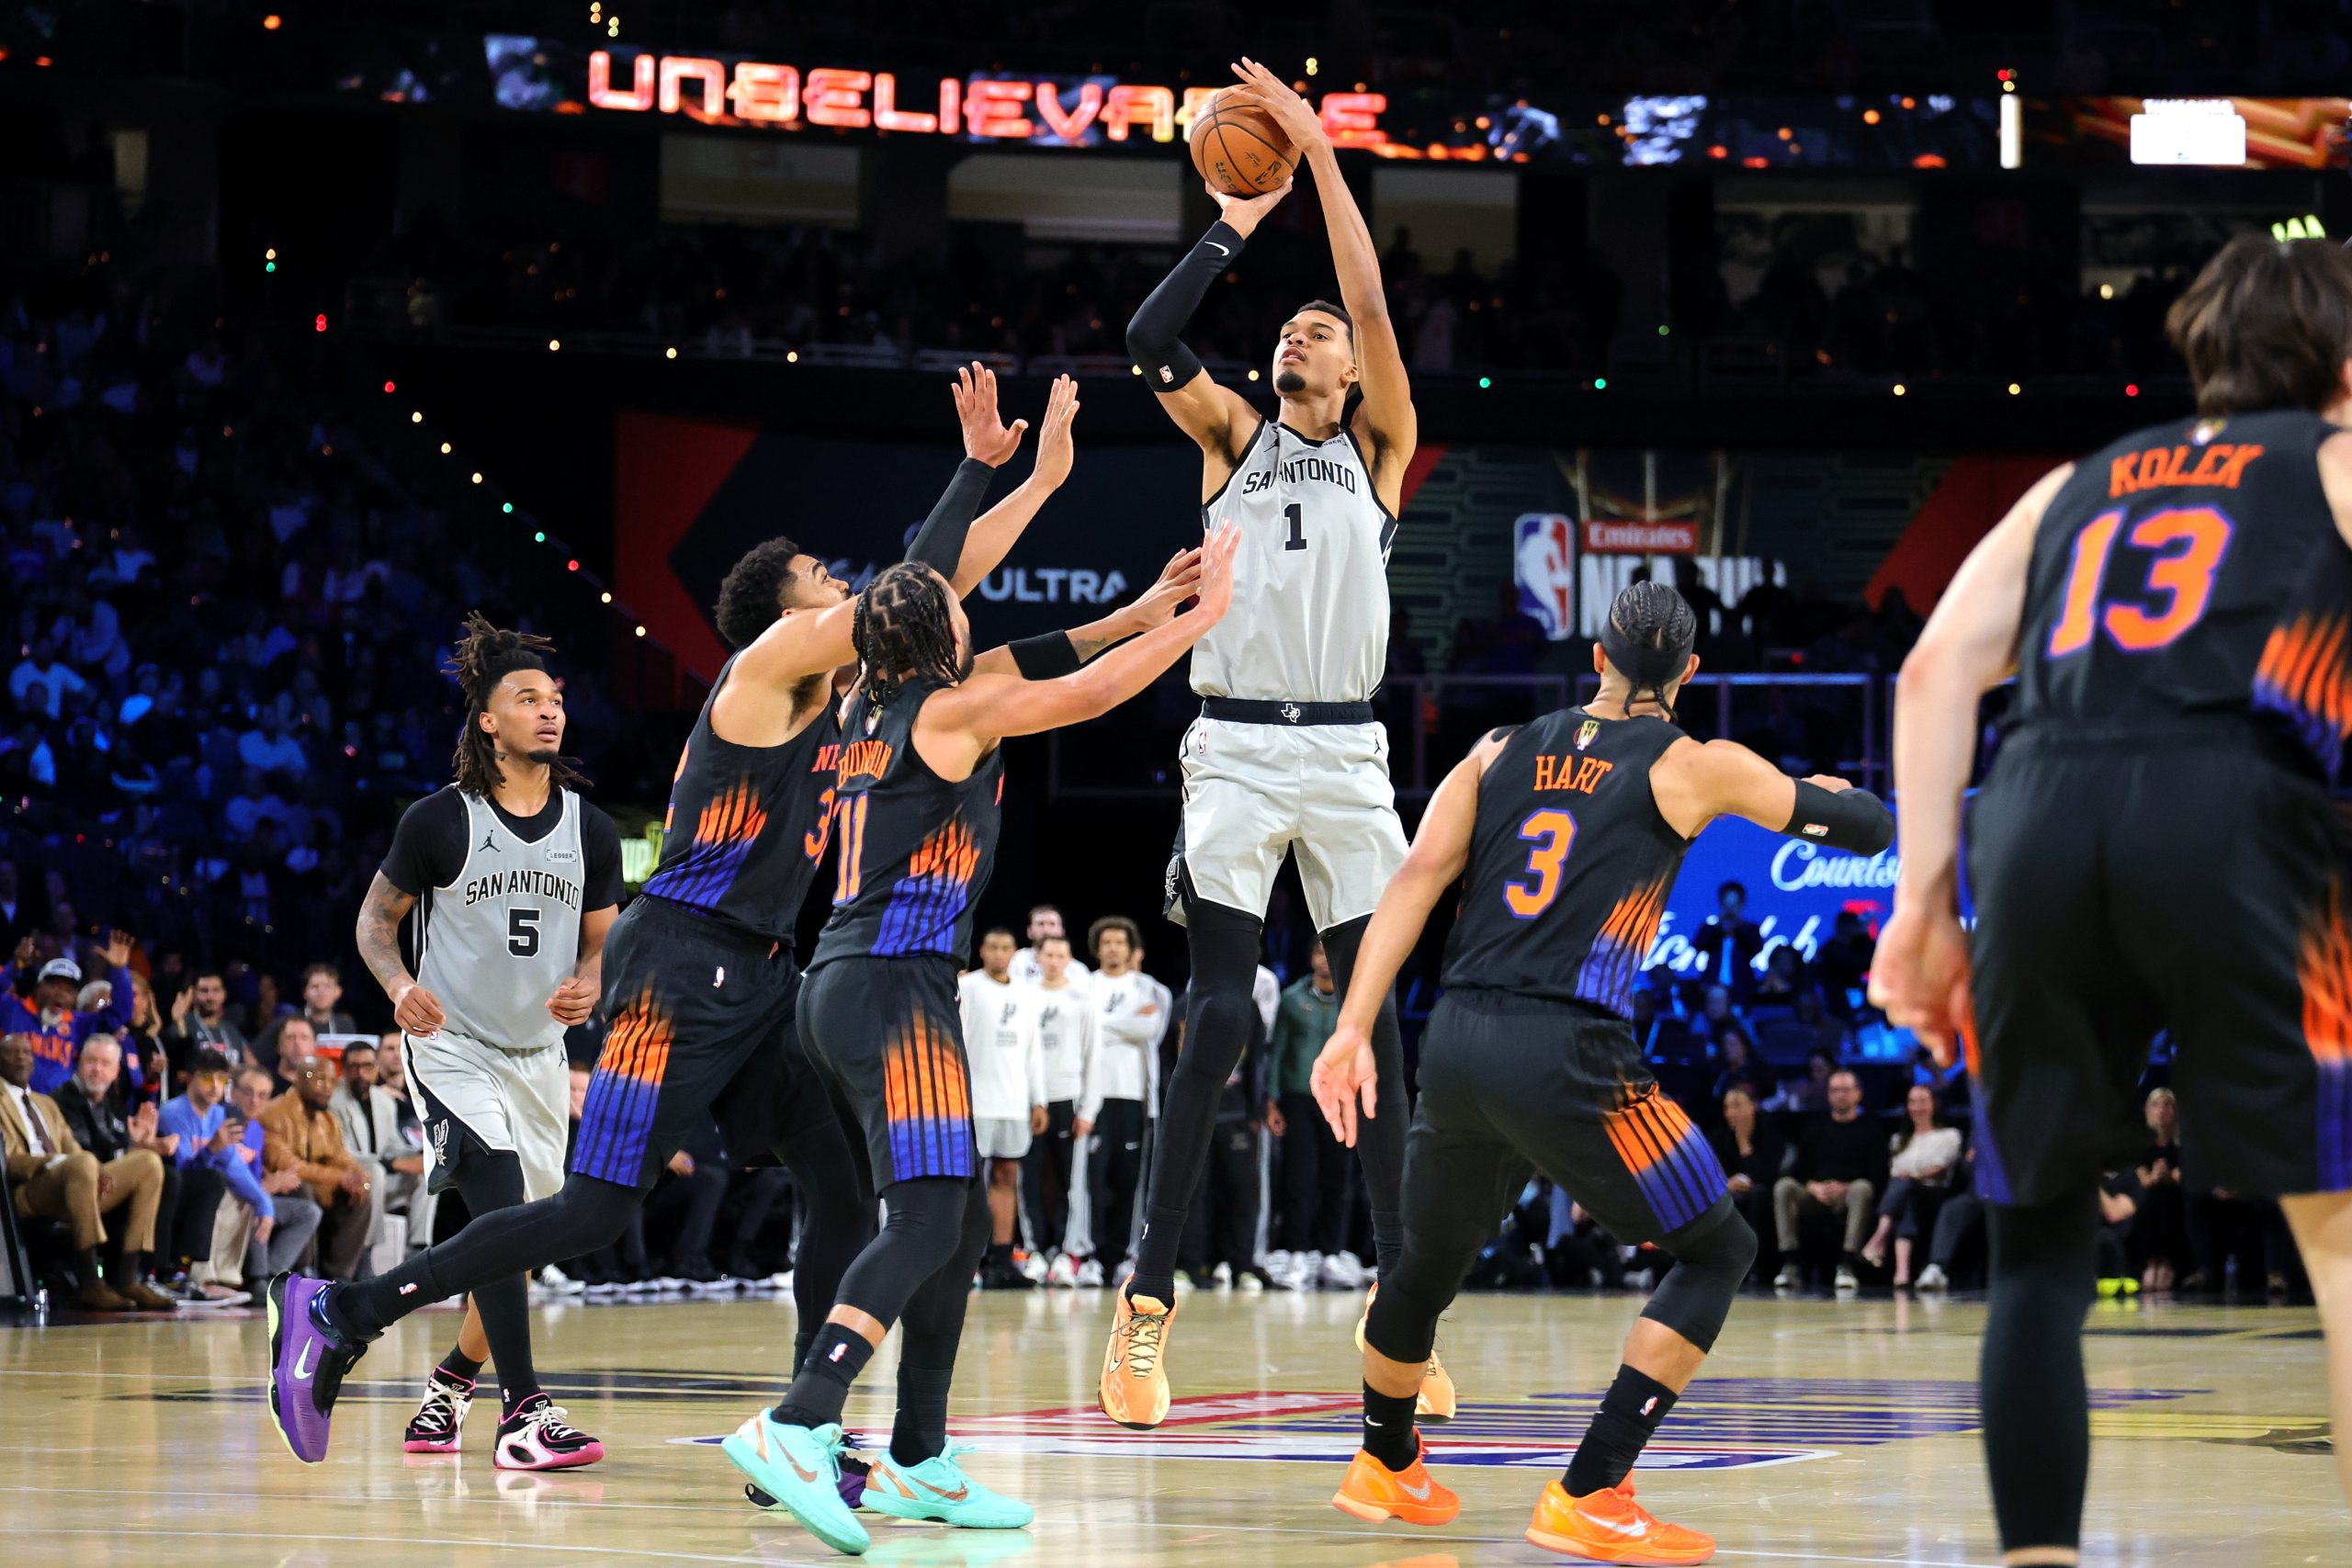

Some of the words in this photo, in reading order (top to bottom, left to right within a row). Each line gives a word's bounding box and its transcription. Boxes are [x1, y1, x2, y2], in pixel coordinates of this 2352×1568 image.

[1283, 502, 1307, 551] 1
[1588, 523, 1691, 548] Emirates
[2046, 503, 2236, 660] 13
[1533, 754, 1612, 795] HART
[1502, 807, 1577, 919] 3
[466, 872, 503, 907] SAN
[506, 869, 580, 911] ANTONIO
[507, 907, 541, 958] 5
